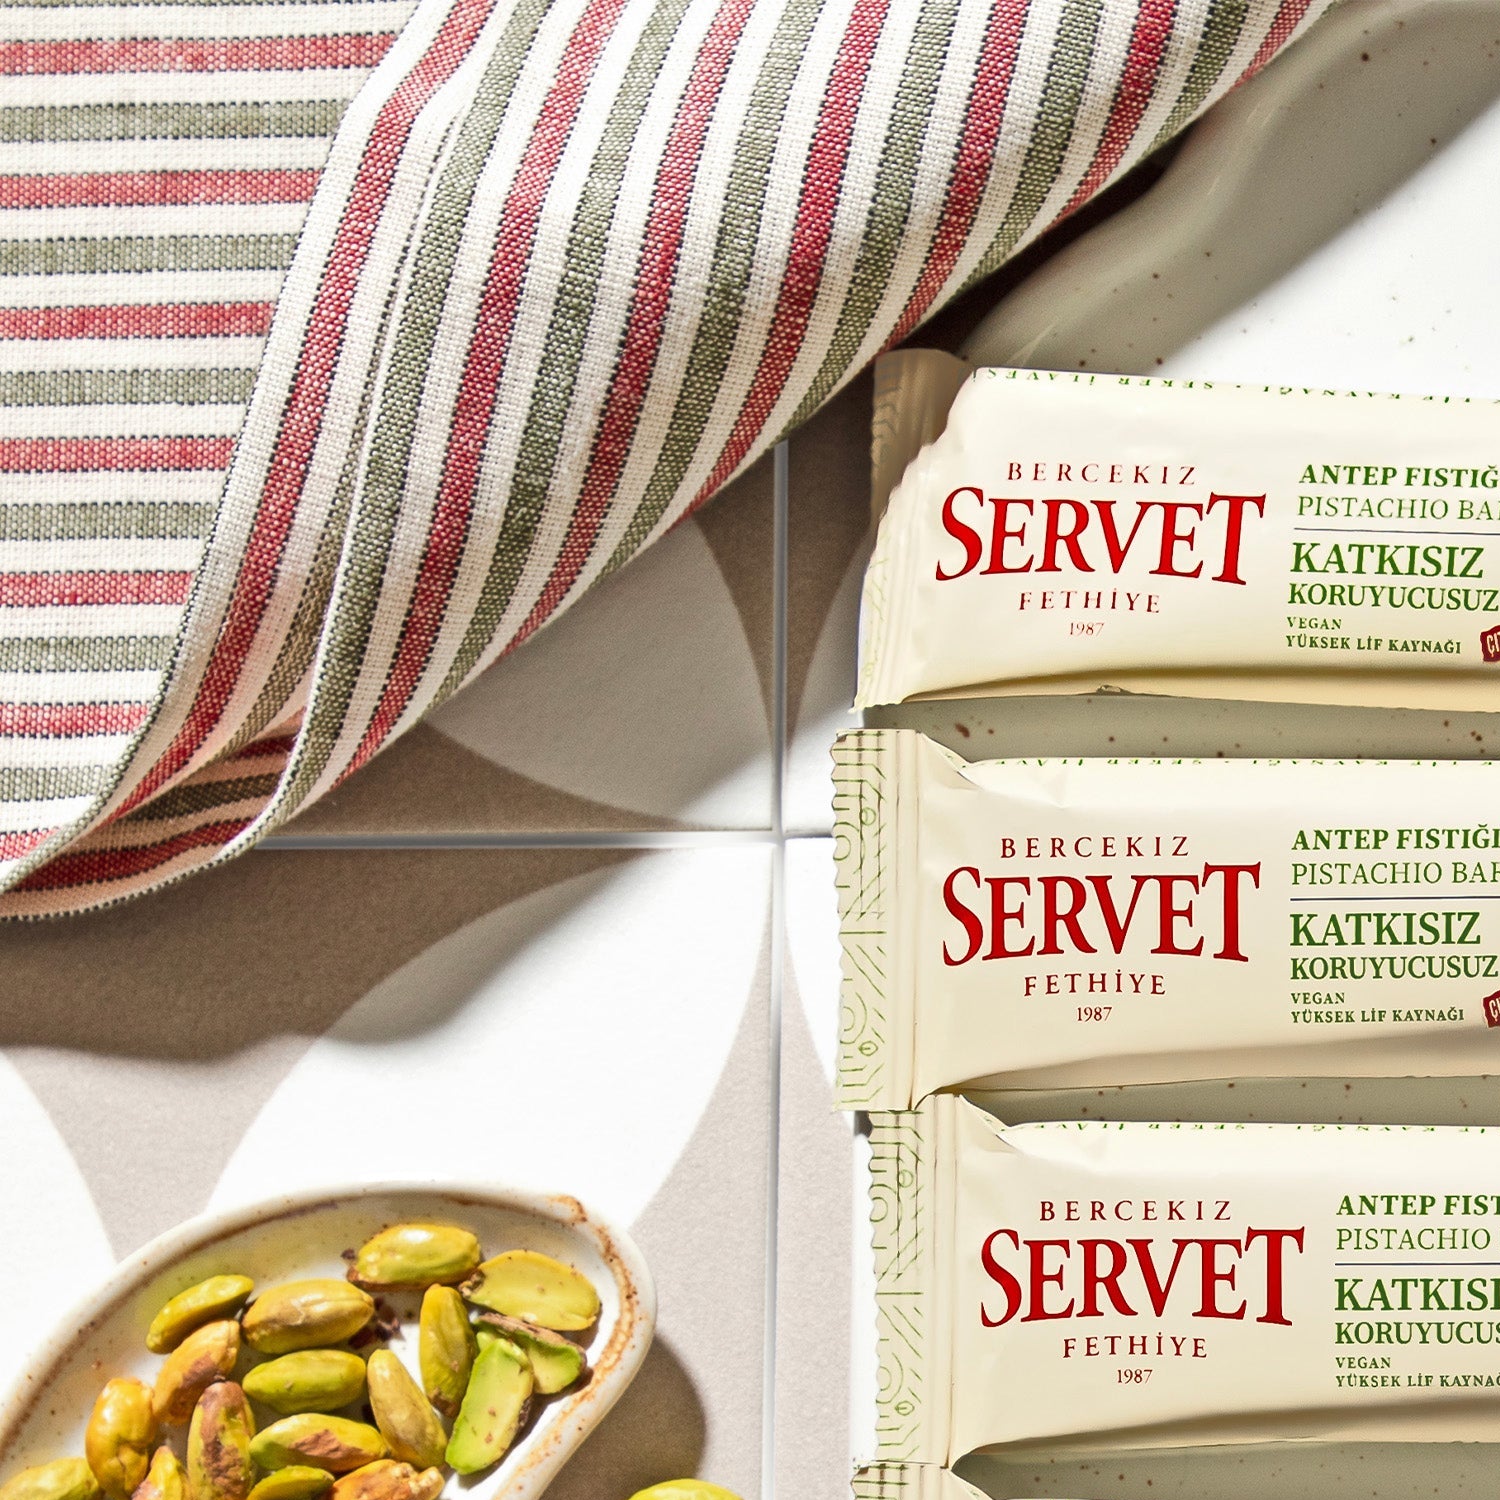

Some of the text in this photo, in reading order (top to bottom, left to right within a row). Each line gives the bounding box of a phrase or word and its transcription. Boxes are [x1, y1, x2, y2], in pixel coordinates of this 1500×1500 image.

[1008, 463, 1195, 485] BERCEKIZ
[1299, 464, 1397, 485] ANTEP
[1298, 496, 1448, 520] PISTACHIO
[936, 487, 1266, 585] SERVET
[1290, 542, 1484, 578] KATKISIZ
[1019, 588, 1159, 613] FETHİYE
[1288, 583, 1499, 612] KORUYUCUSUZ
[1069, 622, 1105, 636] 1987
[1287, 616, 1341, 630] VEGAN
[1286, 633, 1461, 655] YÜKSEK LİF KAYNAĞI
[1000, 836, 1188, 858] BERCEKIZ
[1291, 829, 1389, 850] ANTEP
[1396, 824, 1500, 849] FISTIĞI
[1291, 862, 1442, 885] PISTACHIO
[943, 861, 1261, 966] SERVET
[1290, 912, 1481, 946] KATKISIZ
[1290, 955, 1498, 980] KORUYUCUSUZ
[1024, 969, 1165, 997] FETHİYE
[1291, 992, 1345, 1005] VEGAN
[1078, 1006, 1112, 1022] 1987
[1291, 1006, 1465, 1024] YÜKSEK LİF KAYNAĞI
[1040, 1200, 1231, 1221] BERCEKIZ
[1336, 1195, 1436, 1215] ANTEP
[1336, 1228, 1491, 1250] PISTACHIO
[981, 1226, 1305, 1327] SERVET
[1063, 1332, 1207, 1358] FETHİYE
[1335, 1356, 1391, 1369] VEGAN
[1117, 1369, 1153, 1384] 1987
[1336, 1373, 1401, 1388] YÜKSEK
[1407, 1373, 1433, 1387] LİF
